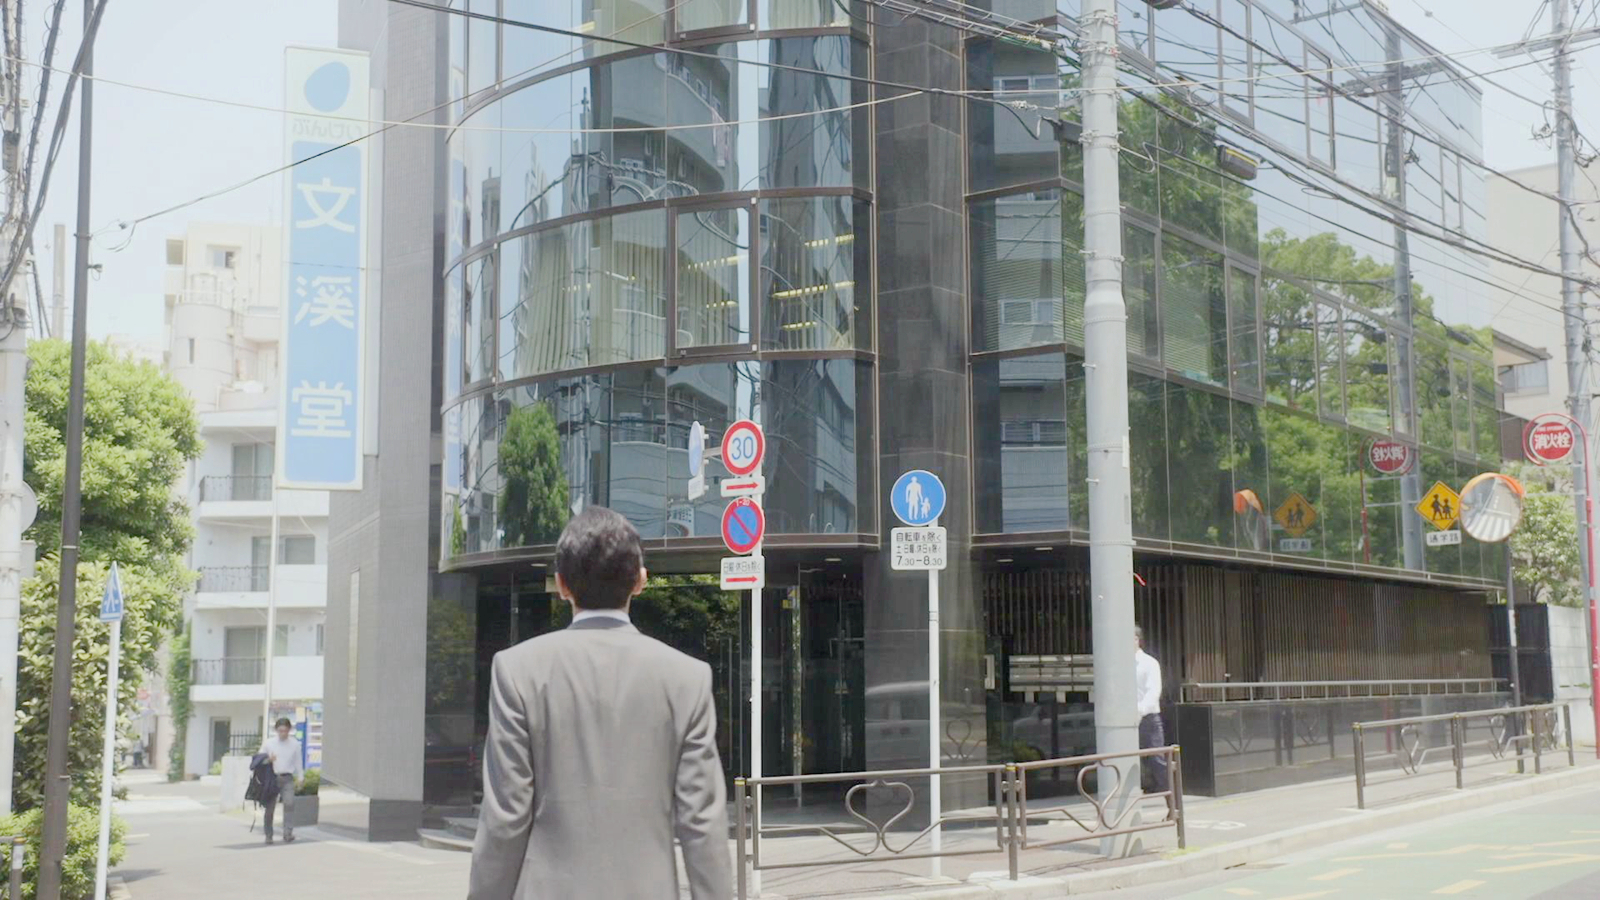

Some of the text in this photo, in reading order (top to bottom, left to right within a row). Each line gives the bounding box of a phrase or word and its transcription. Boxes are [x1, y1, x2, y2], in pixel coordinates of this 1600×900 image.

[732, 437, 753, 460] 30
[1534, 432, 1571, 450] 消火栓
[896, 532, 941, 542] 自転車を除く
